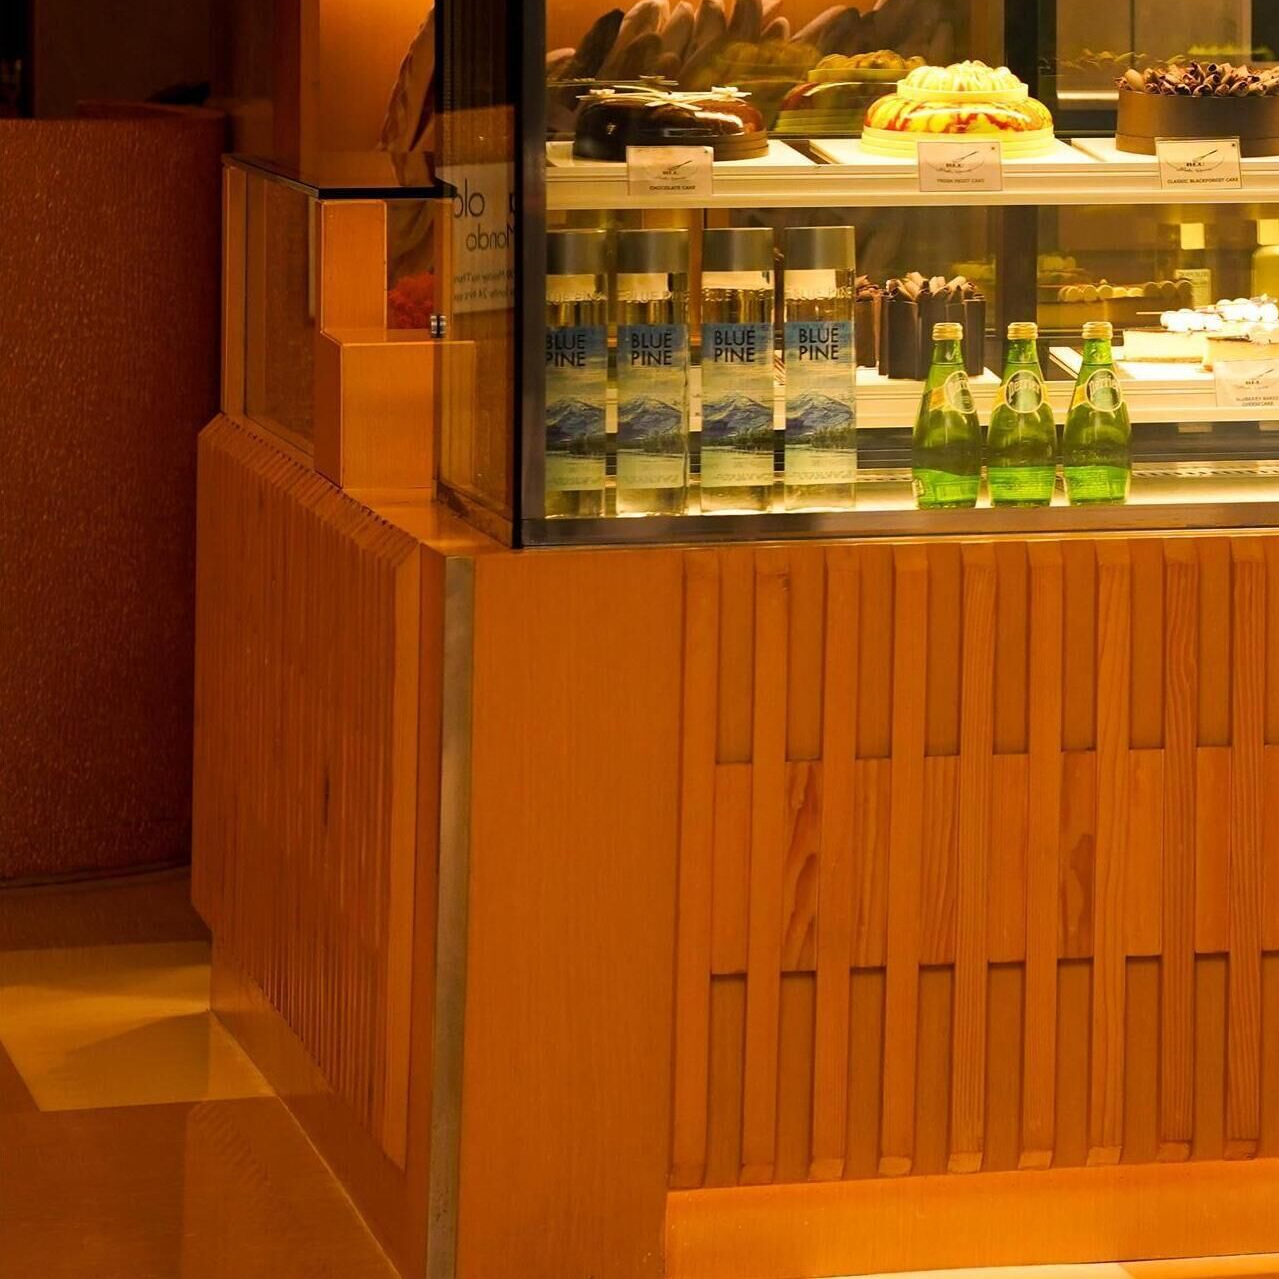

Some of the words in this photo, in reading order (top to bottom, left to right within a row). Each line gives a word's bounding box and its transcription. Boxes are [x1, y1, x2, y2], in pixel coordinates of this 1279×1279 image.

[632, 334, 672, 348] BLUE
[715, 330, 755, 345] BLUE
[799, 328, 839, 343] BLUE
[632, 351, 672, 366] PINE
[715, 347, 755, 362] PINE
[799, 346, 839, 360] PINE
